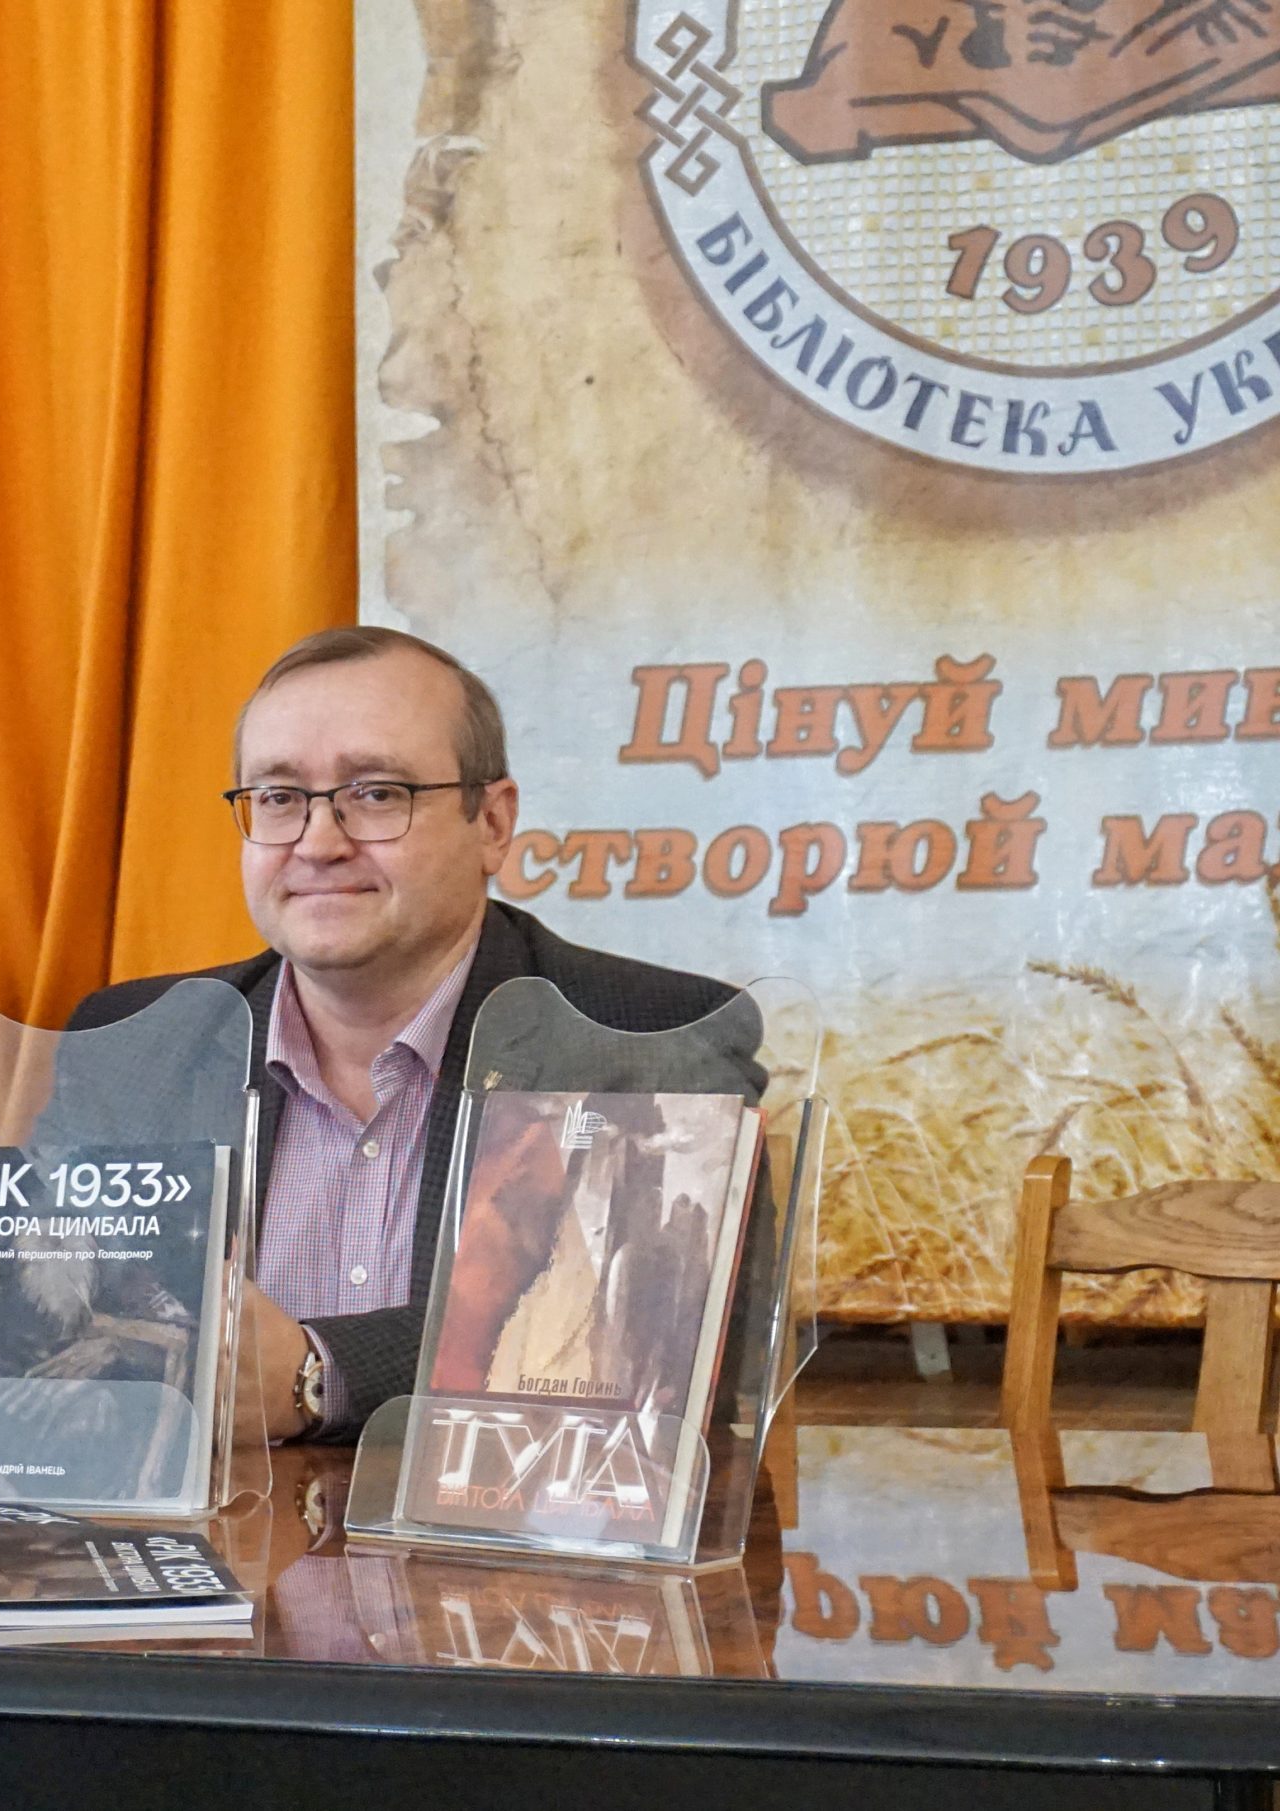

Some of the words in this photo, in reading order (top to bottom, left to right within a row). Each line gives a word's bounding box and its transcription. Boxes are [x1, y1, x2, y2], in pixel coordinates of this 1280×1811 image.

[946, 192, 1240, 315] 1939
[695, 210, 1119, 457] БІБЛІОТЕКА
[1152, 331, 1280, 446] УК
[617, 652, 1002, 781] Цінуй
[495, 790, 1047, 918] створюй
[1091, 807, 1280, 889] ма
[48, 1161, 193, 1208] 1933»
[49, 1215, 160, 1240] ЦИМБАЛА
[18, 1249, 72, 1261] першотвір
[75, 1251, 96, 1261] про
[97, 1249, 154, 1261] Голодомор
[517, 1374, 569, 1396] Богдан
[26, 1465, 66, 1476] ІВАНЕЦЬ
